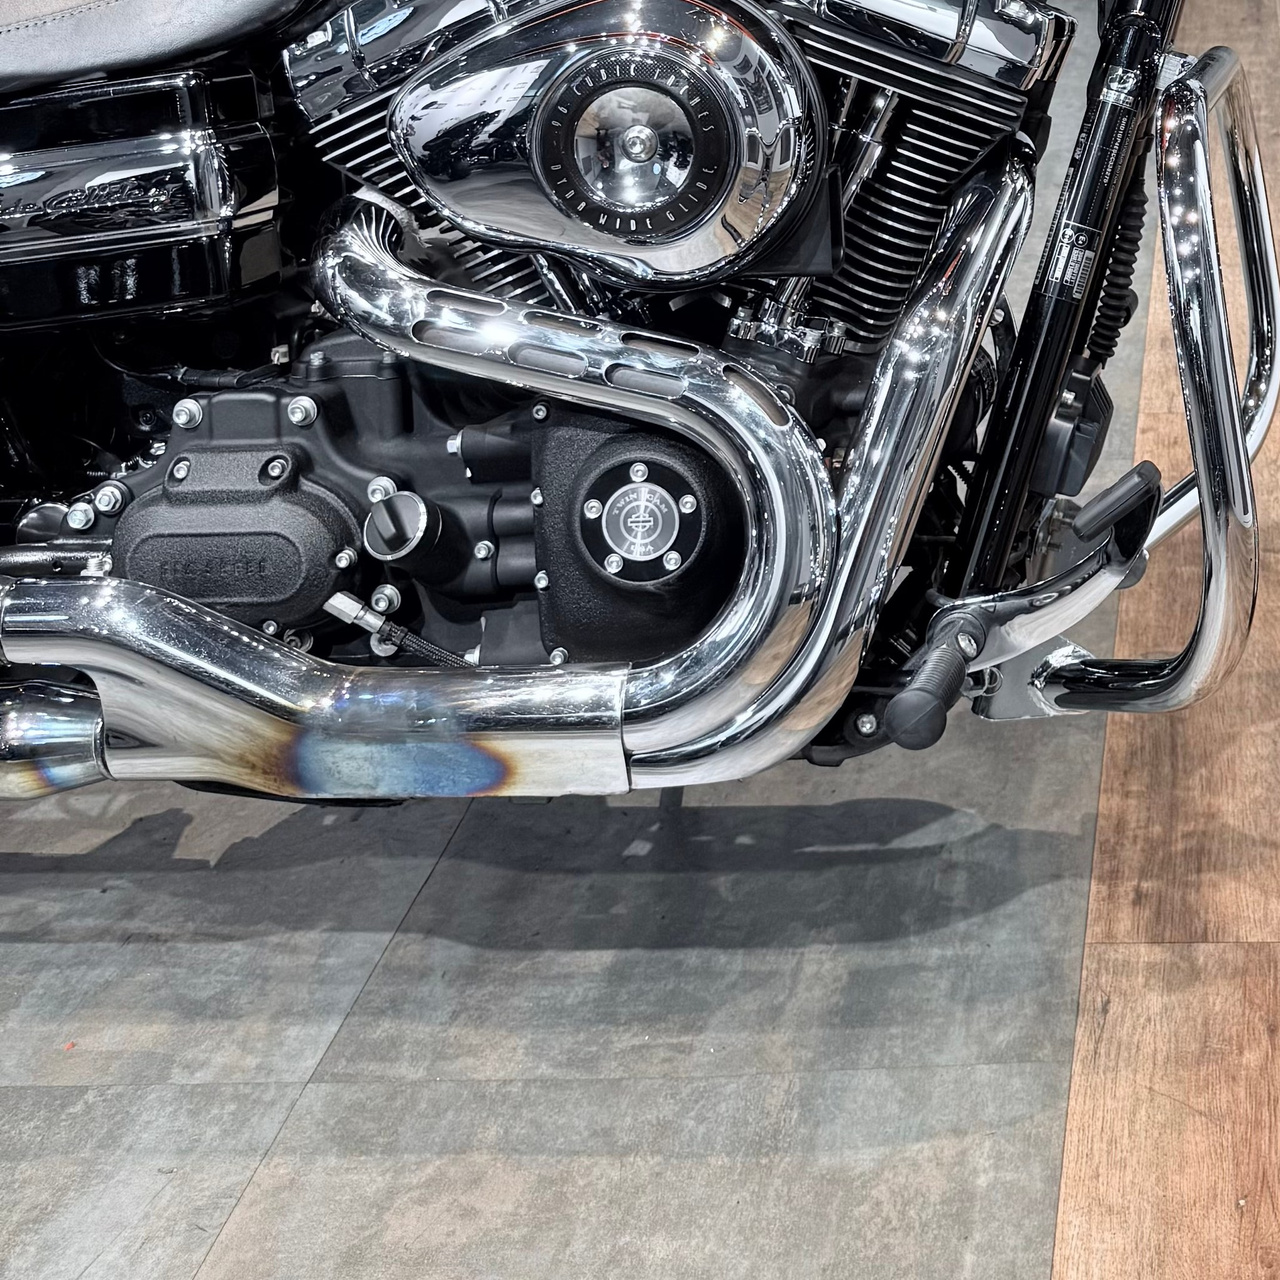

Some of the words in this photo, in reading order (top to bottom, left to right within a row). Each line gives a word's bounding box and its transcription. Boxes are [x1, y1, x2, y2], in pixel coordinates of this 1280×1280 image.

[573, 63, 637, 97] CUBIC
[653, 68, 716, 133] INCHES
[550, 163, 588, 212] DYNA
[598, 213, 653, 232] WIDE
[665, 165, 717, 222] GLIDE
[612, 492, 638, 516] TWIN
[646, 493, 669, 514] CAM
